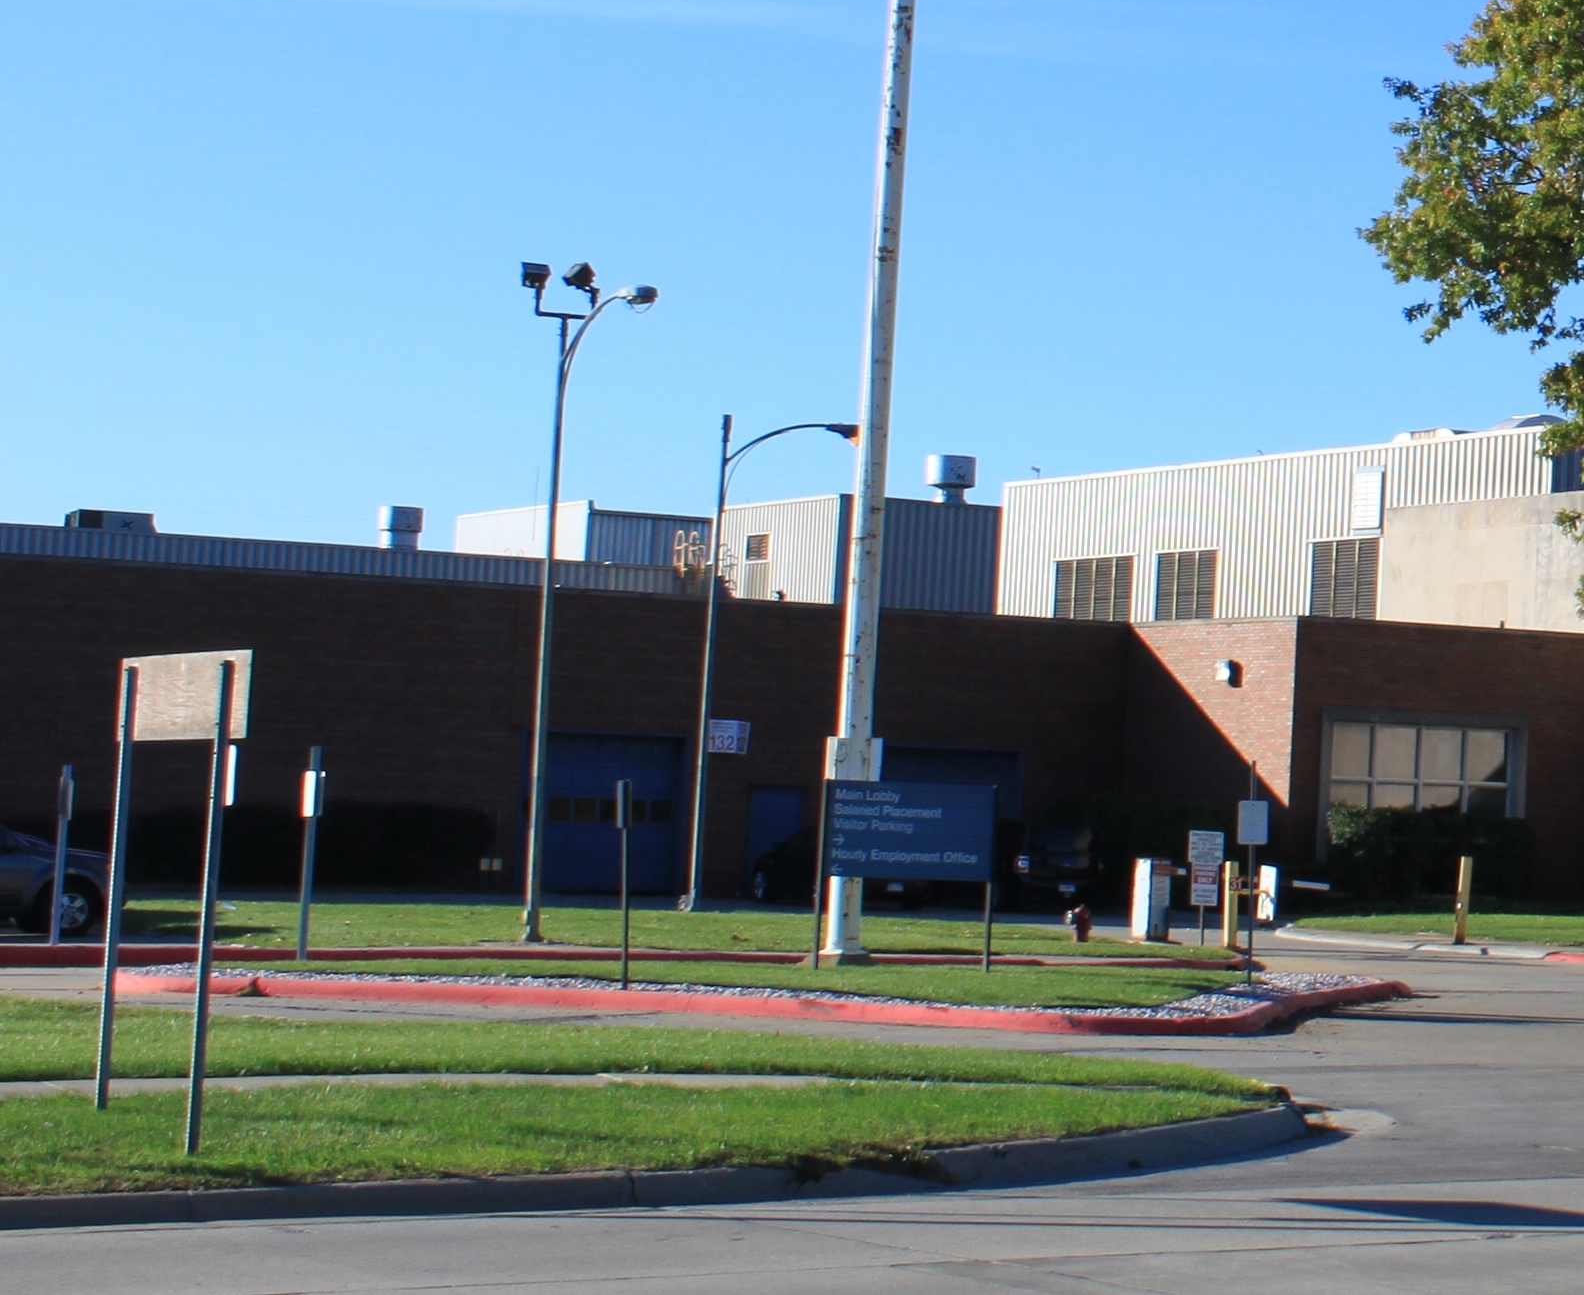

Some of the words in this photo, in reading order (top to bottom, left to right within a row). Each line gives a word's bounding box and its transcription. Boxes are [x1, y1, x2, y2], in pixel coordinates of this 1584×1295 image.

[710, 734, 735, 751] 132
[835, 788, 863, 800] Main
[866, 789, 901, 803] Lobby
[834, 803, 879, 816] Salaried
[882, 806, 942, 819] Placement
[834, 818, 868, 830] Visitor
[871, 819, 914, 834] Parking
[832, 848, 868, 862] Hourly
[871, 849, 940, 864] Employment
[943, 851, 978, 864] Office
